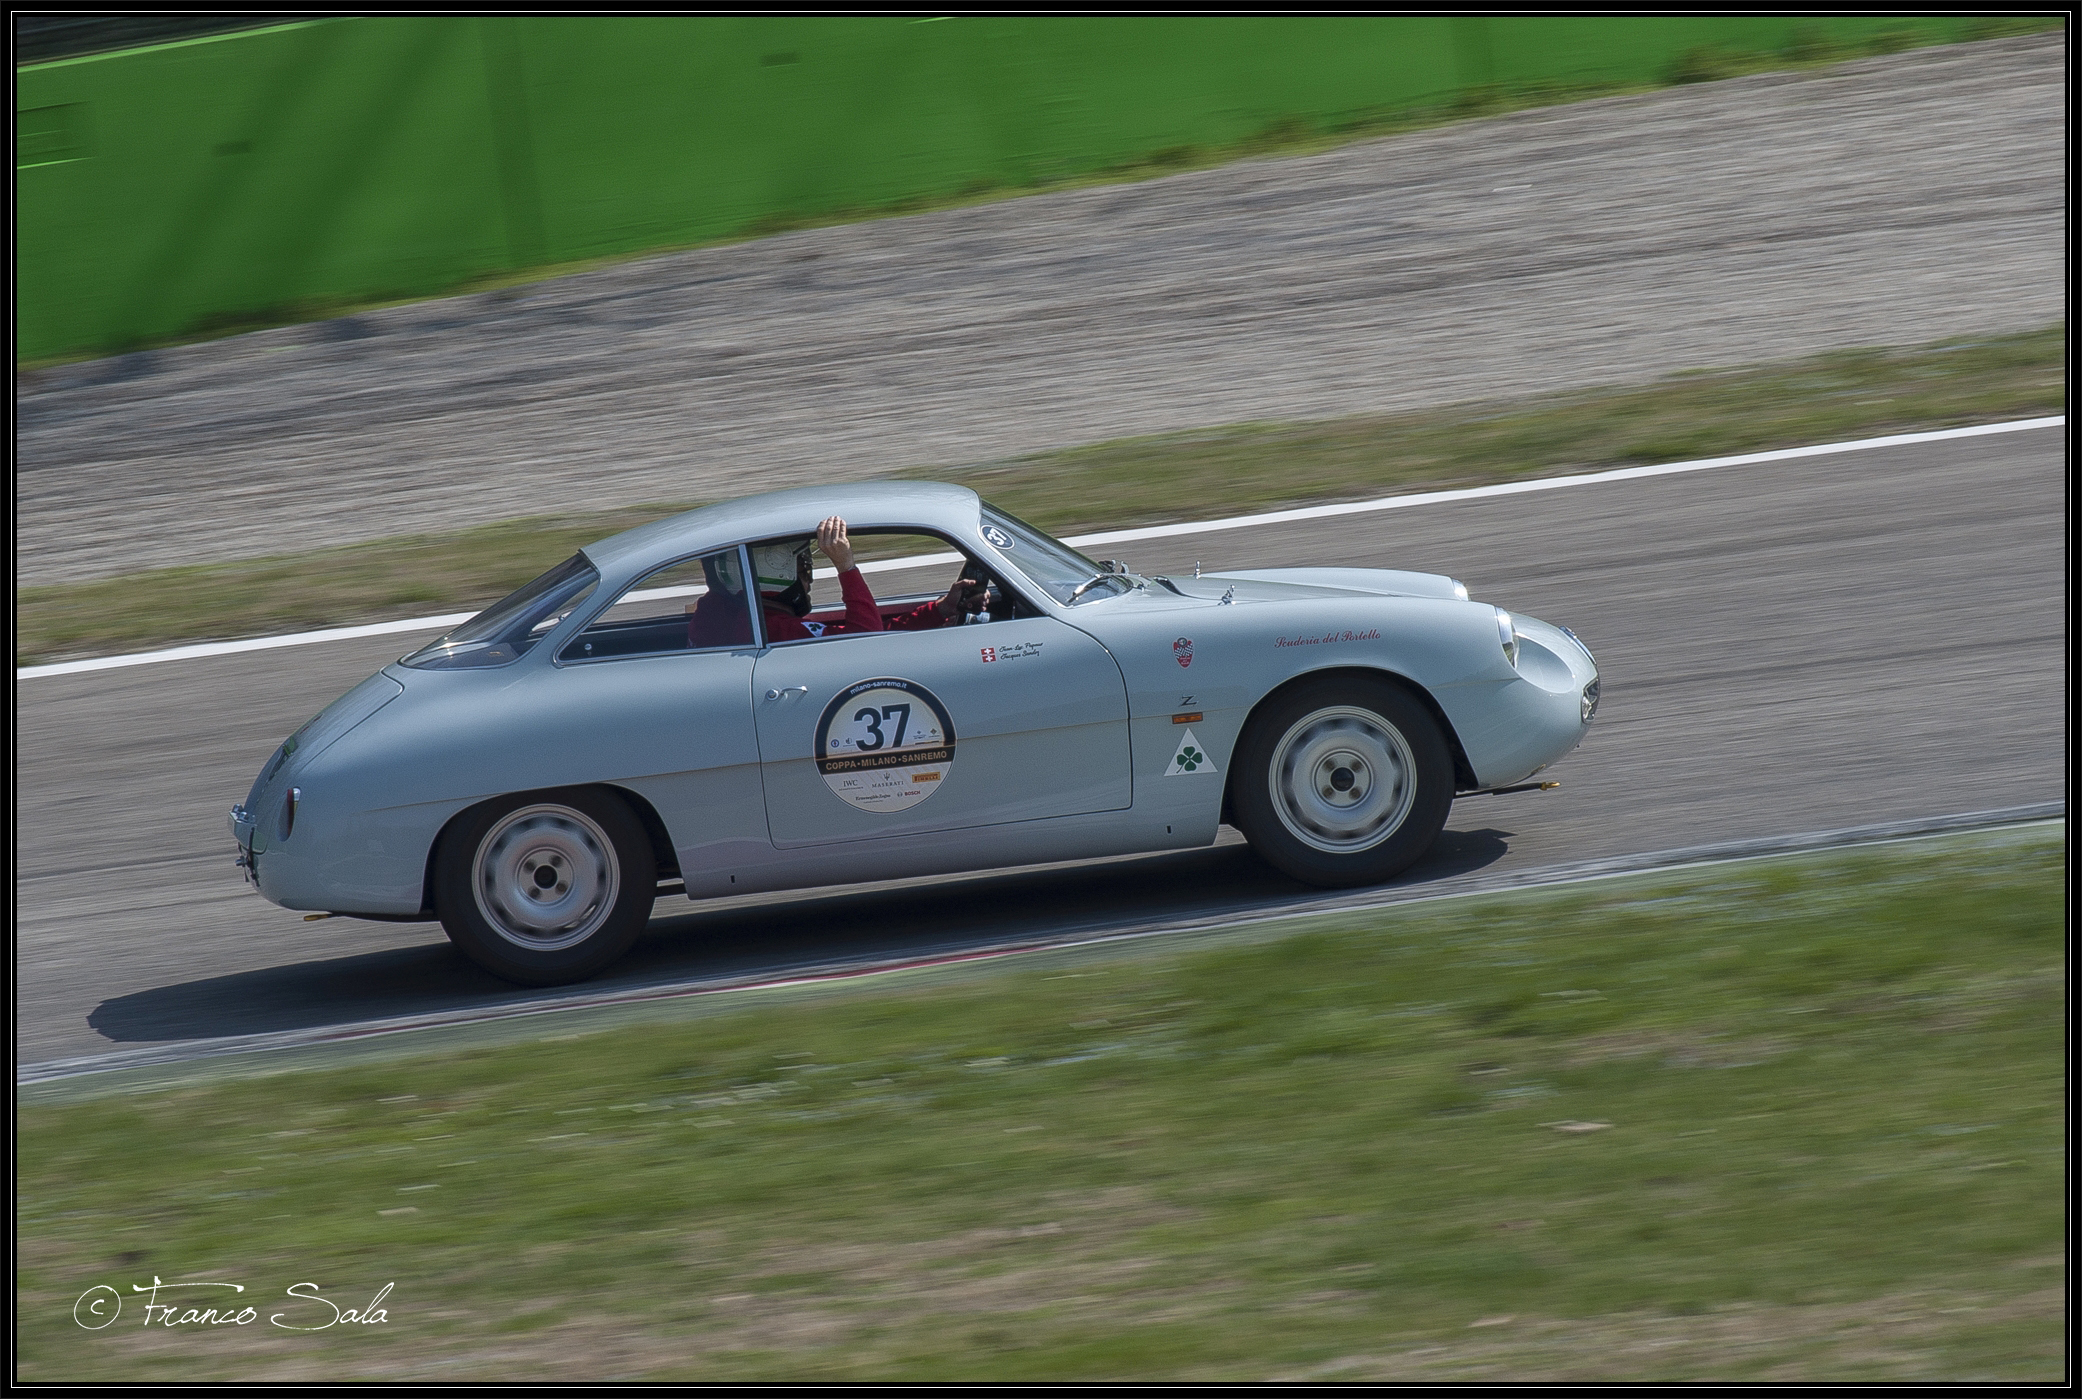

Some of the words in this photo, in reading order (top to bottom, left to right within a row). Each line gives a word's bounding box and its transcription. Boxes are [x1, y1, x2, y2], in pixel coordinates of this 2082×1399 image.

[987, 528, 1007, 546] 37
[1274, 636, 1320, 648] Scuderia
[1322, 632, 1339, 643] del
[1341, 629, 1381, 642] Portello
[850, 680, 908, 695] milano-sanremo.it
[1178, 695, 1198, 707] Z
[853, 703, 911, 752] 37
[825, 760, 857, 771] COPPA
[861, 756, 897, 767] MILANO
[902, 750, 948, 763] SANREMO
